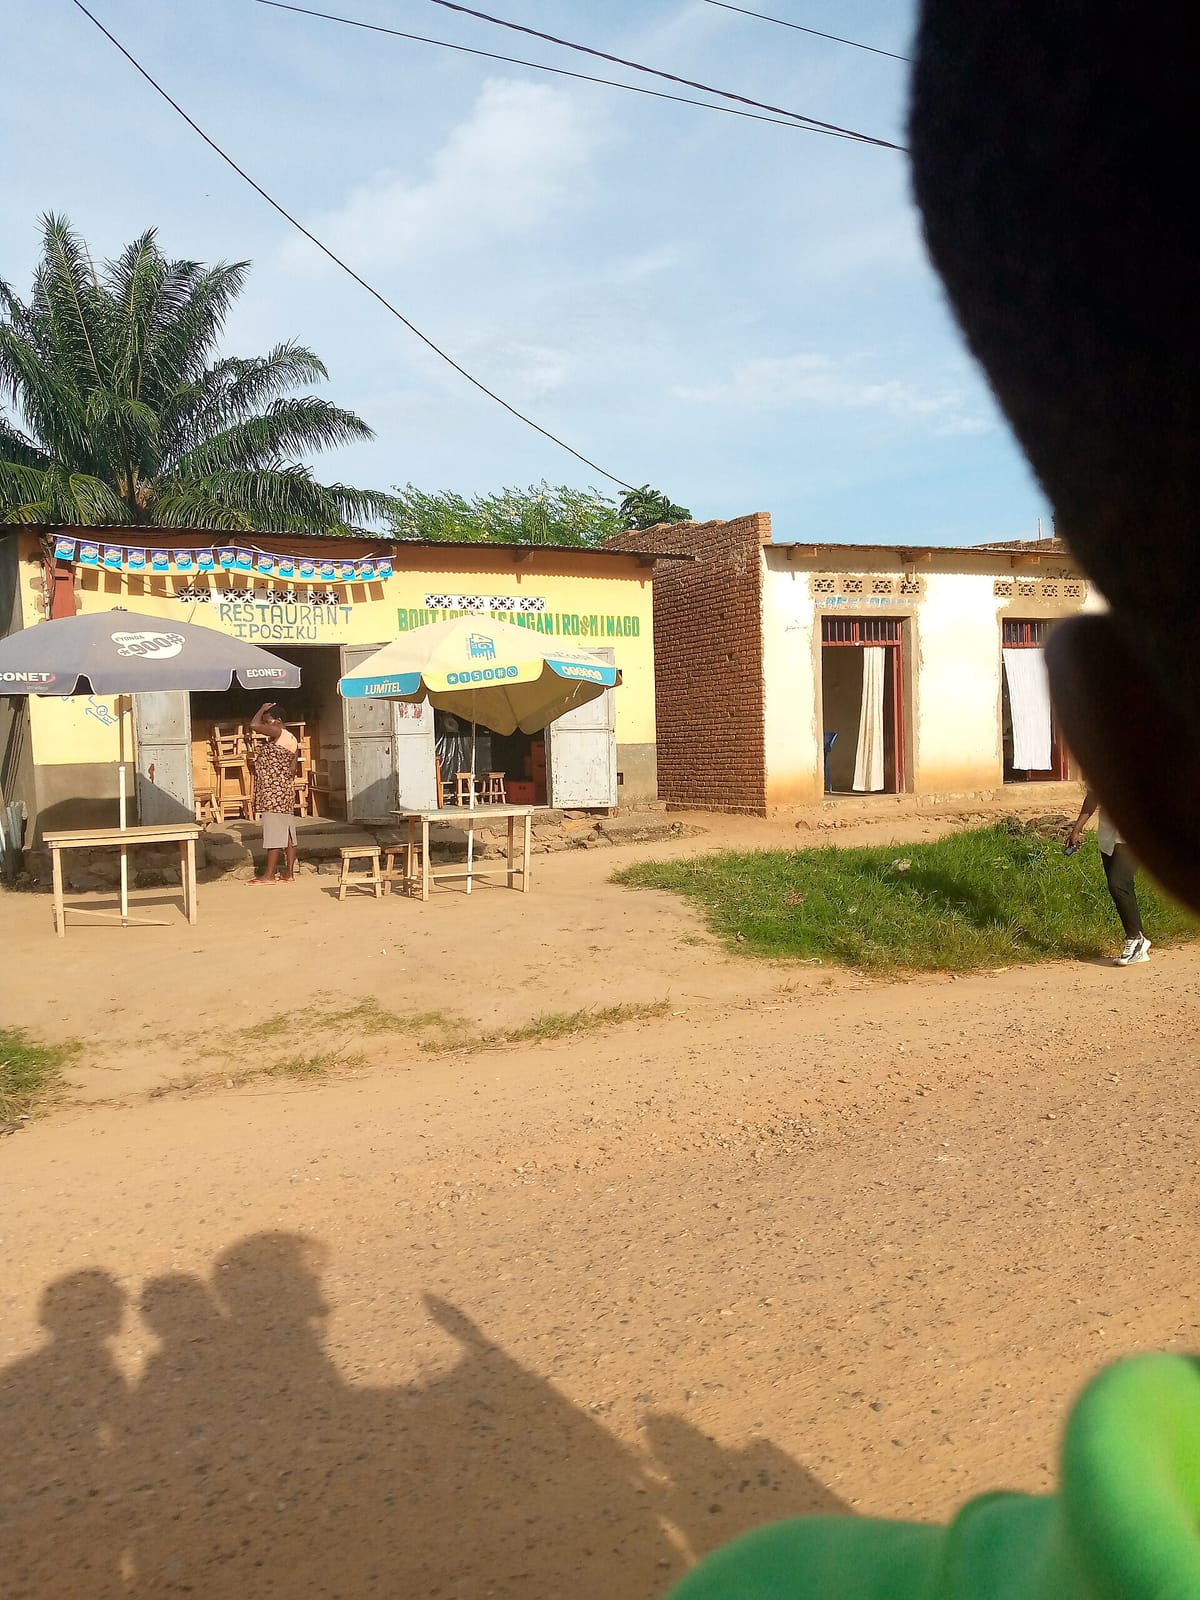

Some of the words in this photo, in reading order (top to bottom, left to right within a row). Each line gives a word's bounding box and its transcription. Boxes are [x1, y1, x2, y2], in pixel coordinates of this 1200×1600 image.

[219, 603, 352, 625] RESTAURANT
[397, 608, 477, 632] BOUTI
[233, 624, 316, 640] IPOSIKU
[0, 672, 50, 682] ONET
[246, 668, 283, 678] ECONET
[365, 680, 401, 695] LUMITEL
